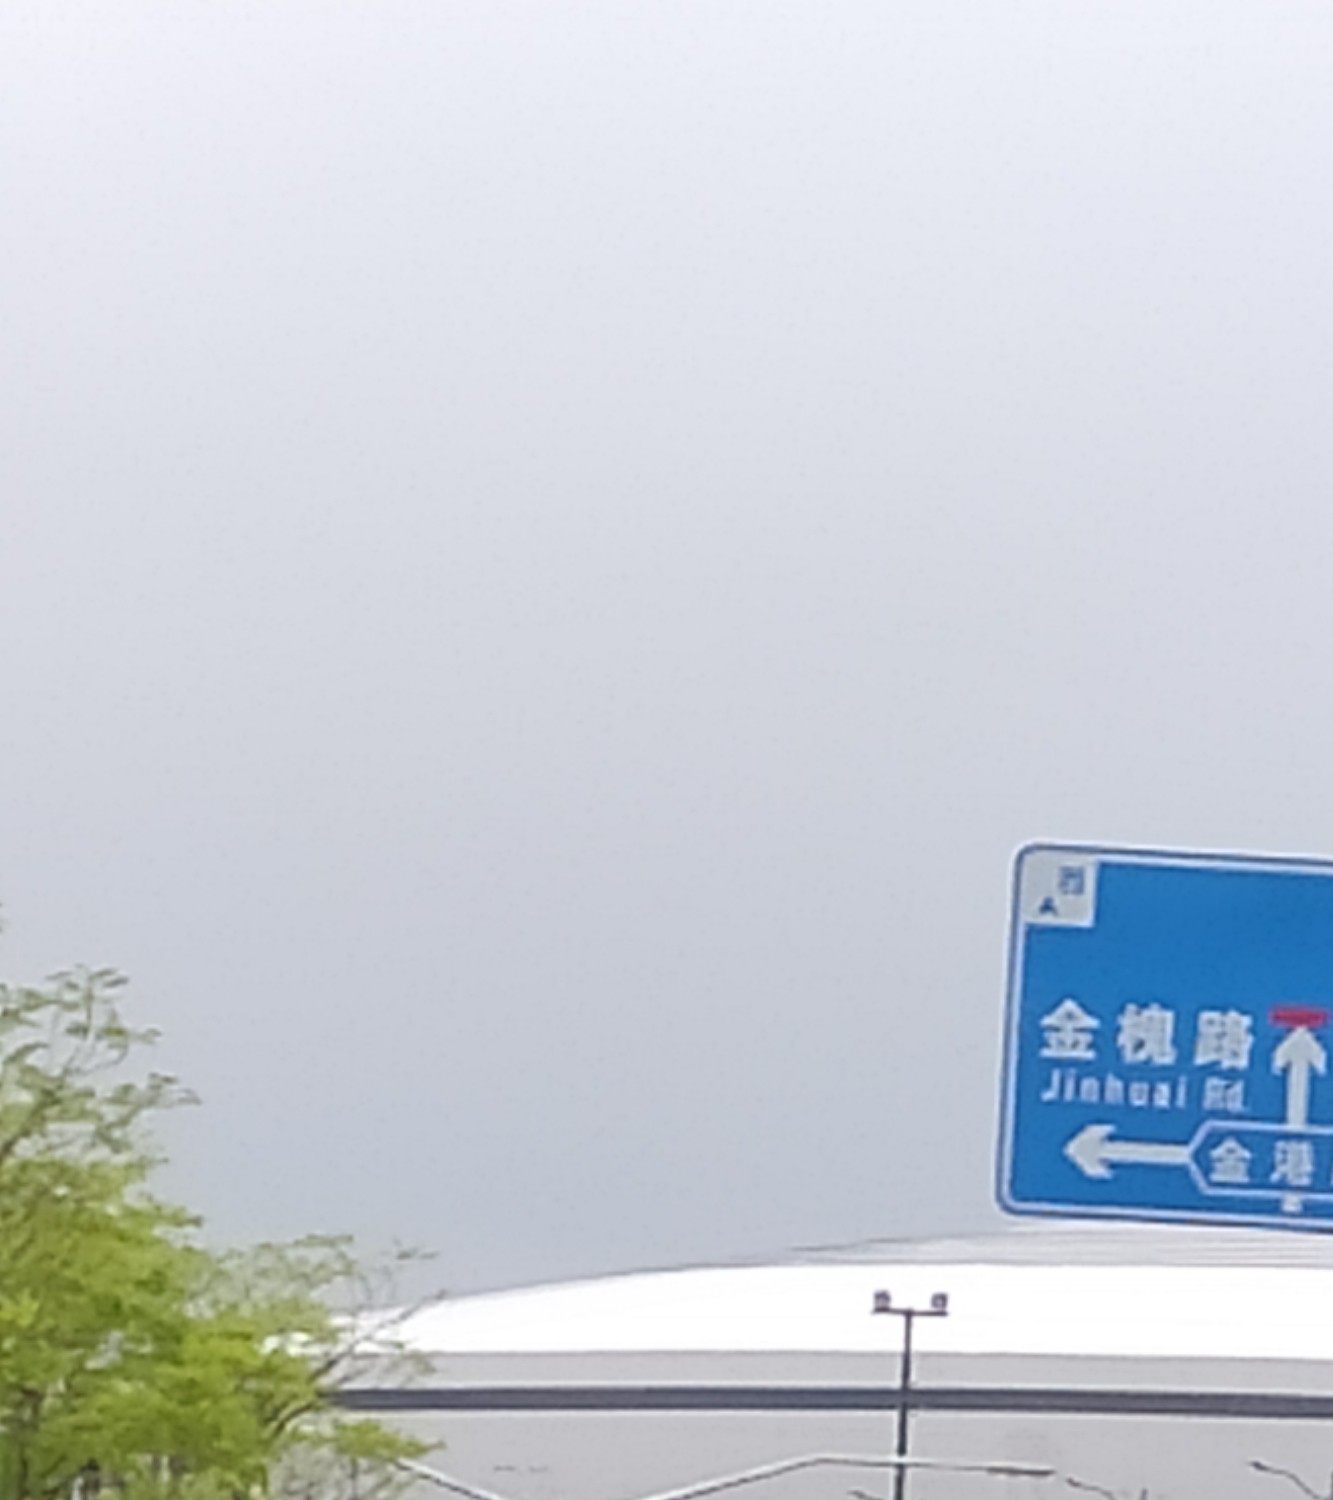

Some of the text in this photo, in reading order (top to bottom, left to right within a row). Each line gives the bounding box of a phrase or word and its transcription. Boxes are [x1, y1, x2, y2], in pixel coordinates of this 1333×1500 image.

[1040, 998, 1254, 1070] 金槐路
[1040, 1068, 1247, 1112] Jinhuai Rd
